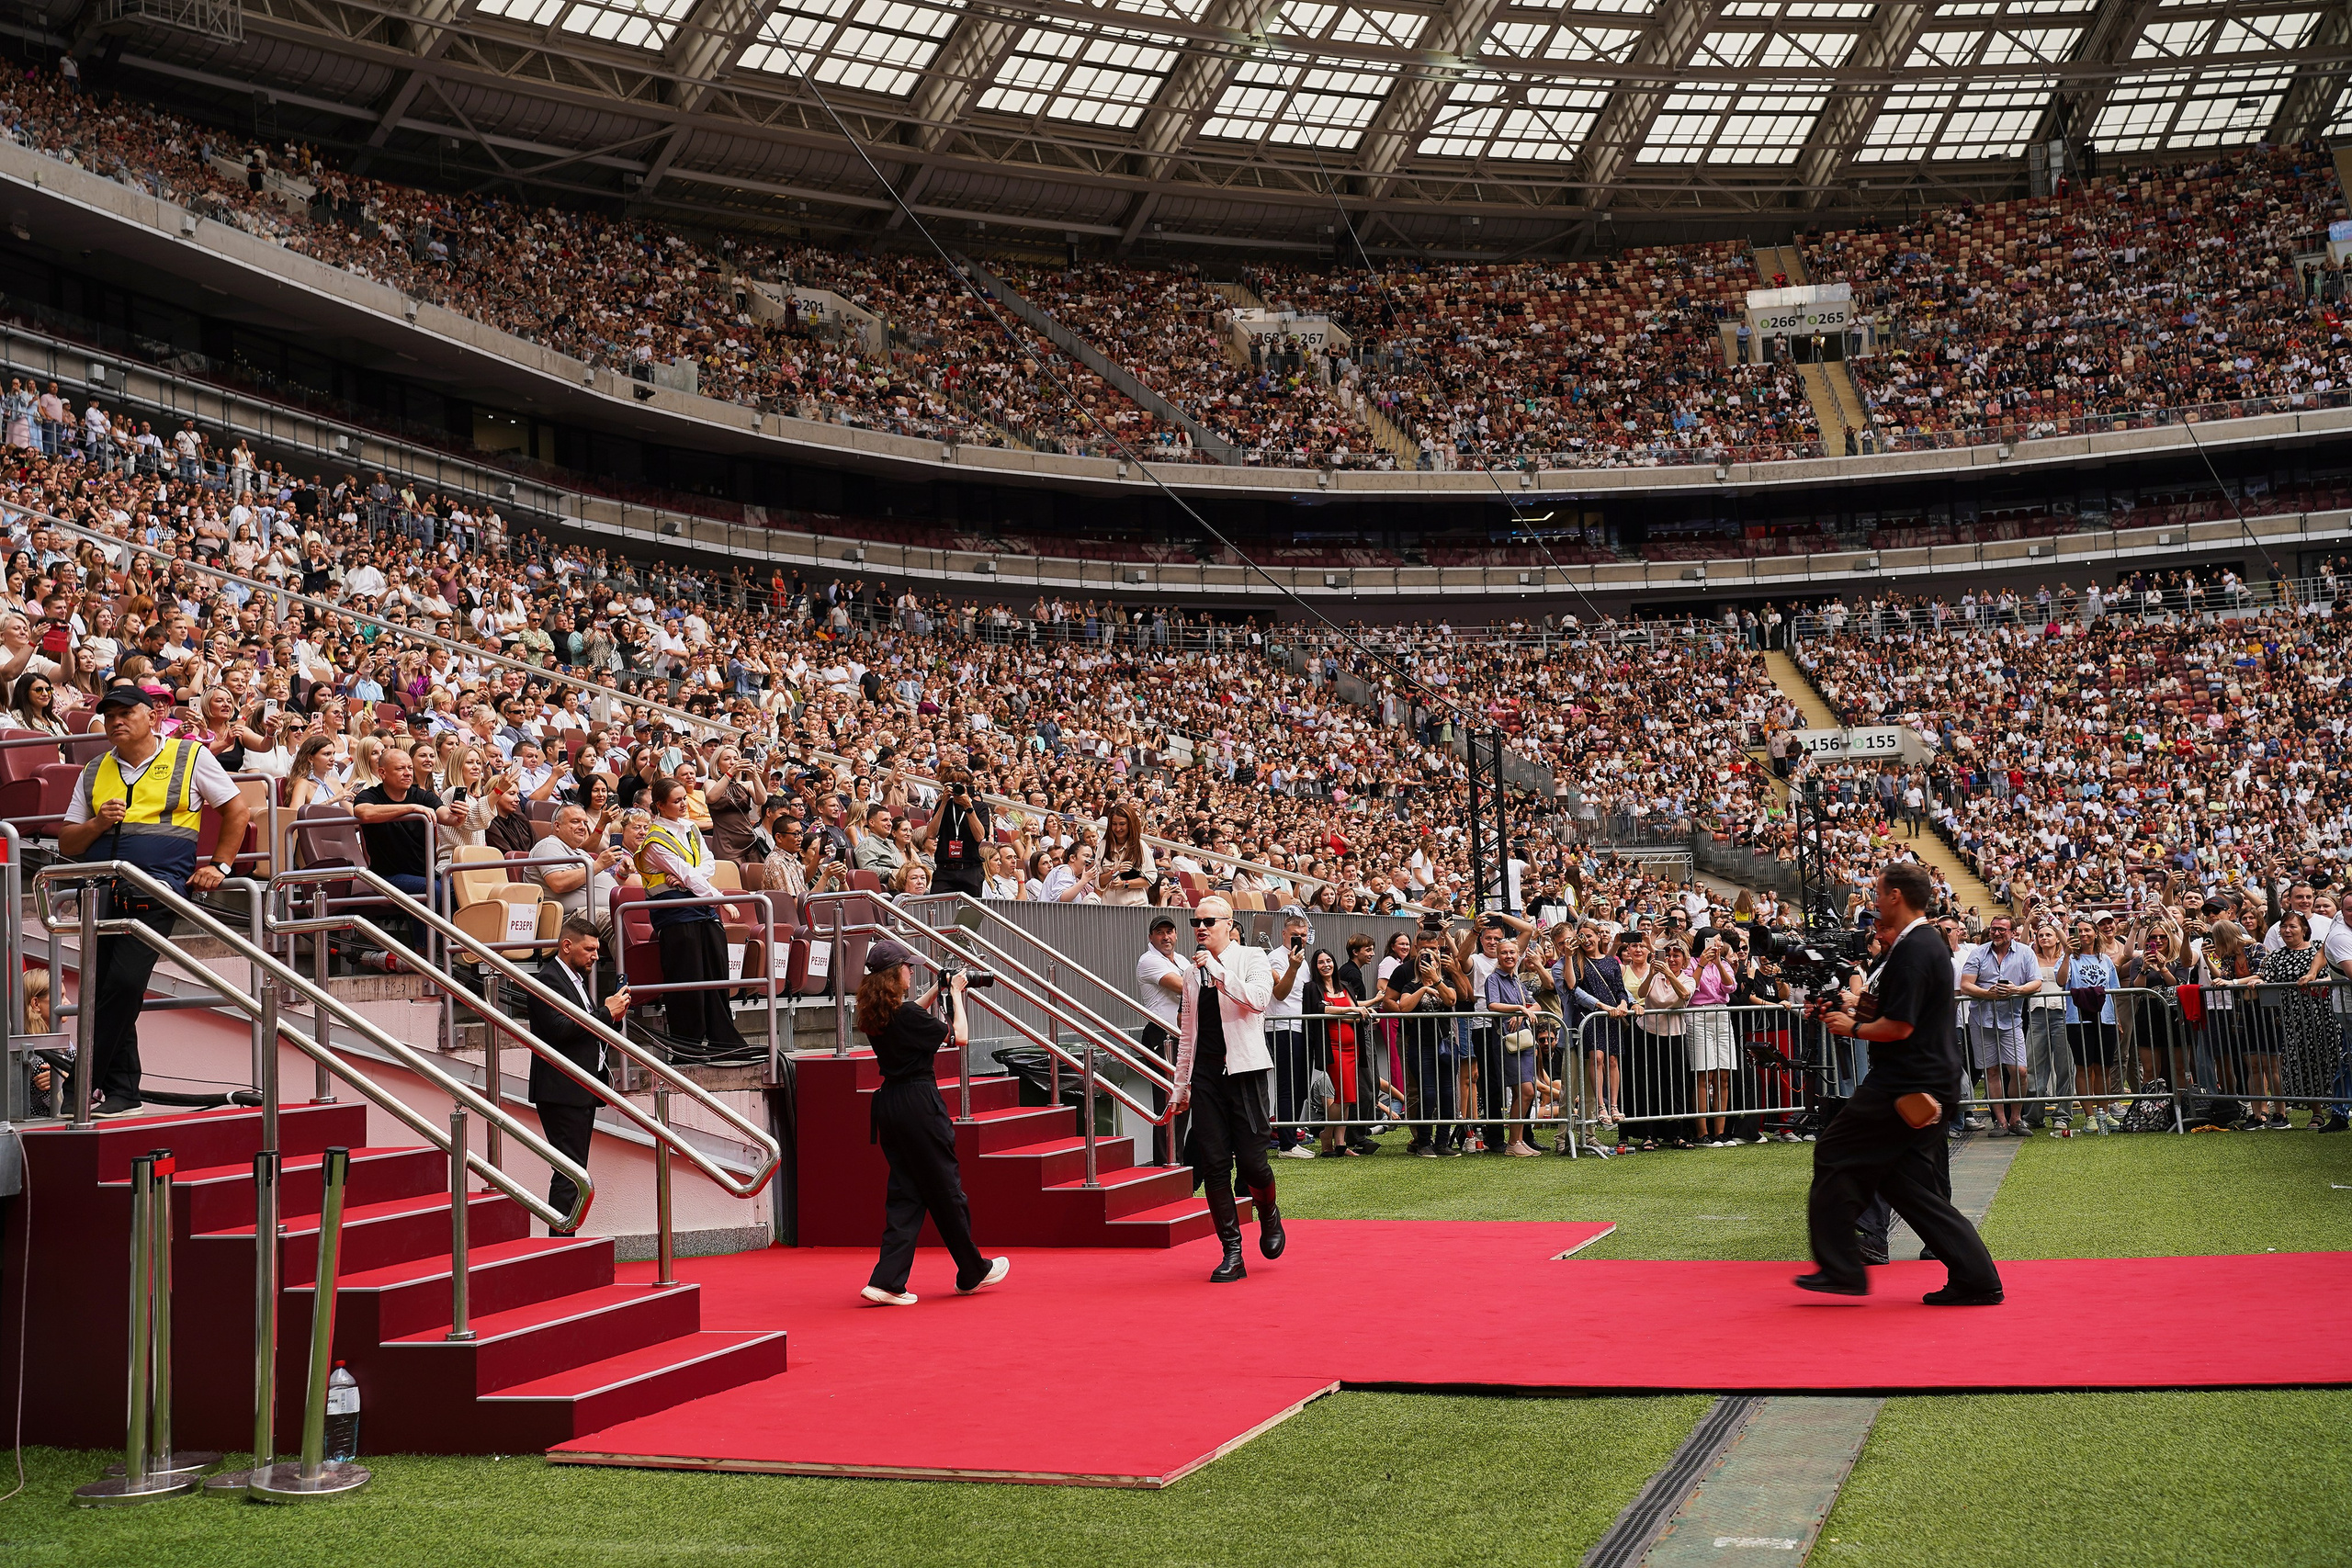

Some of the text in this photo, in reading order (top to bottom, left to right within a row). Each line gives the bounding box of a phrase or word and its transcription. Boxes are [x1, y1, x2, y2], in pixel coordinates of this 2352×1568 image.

[803, 299, 825, 313] 201
[1770, 316, 1796, 328] 266
[1818, 312, 1844, 324] 265
[1263, 333, 1279, 344] 68
[1300, 333, 1324, 344] 267
[1810, 738, 1840, 751] 156
[1866, 735, 1896, 749] 155
[511, 920, 533, 931] РЕЗЕРВ
[811, 956, 828, 966] РЕЗЕРВ
